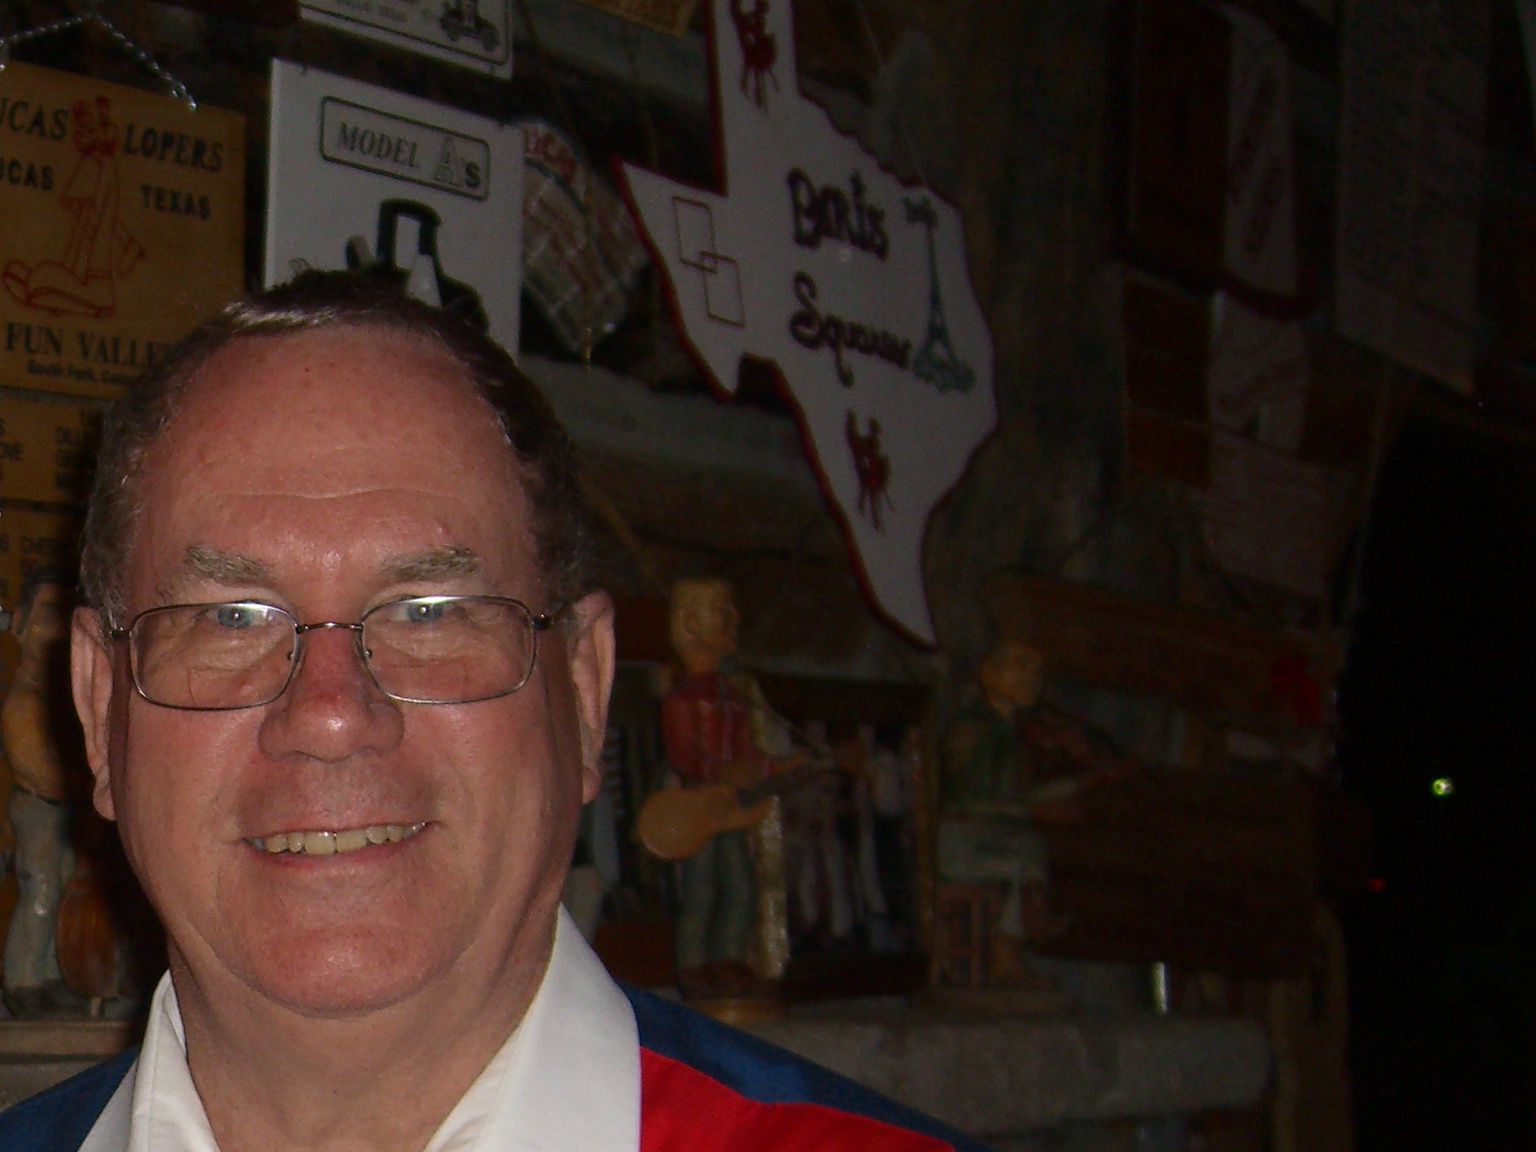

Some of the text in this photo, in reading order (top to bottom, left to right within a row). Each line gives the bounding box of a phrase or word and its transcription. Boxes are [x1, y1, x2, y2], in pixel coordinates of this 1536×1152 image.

[125, 122, 224, 172] LOPERS
[337, 122, 421, 168] MODEL
[142, 184, 210, 220] TEXAS
[6, 322, 64, 356] FUN
